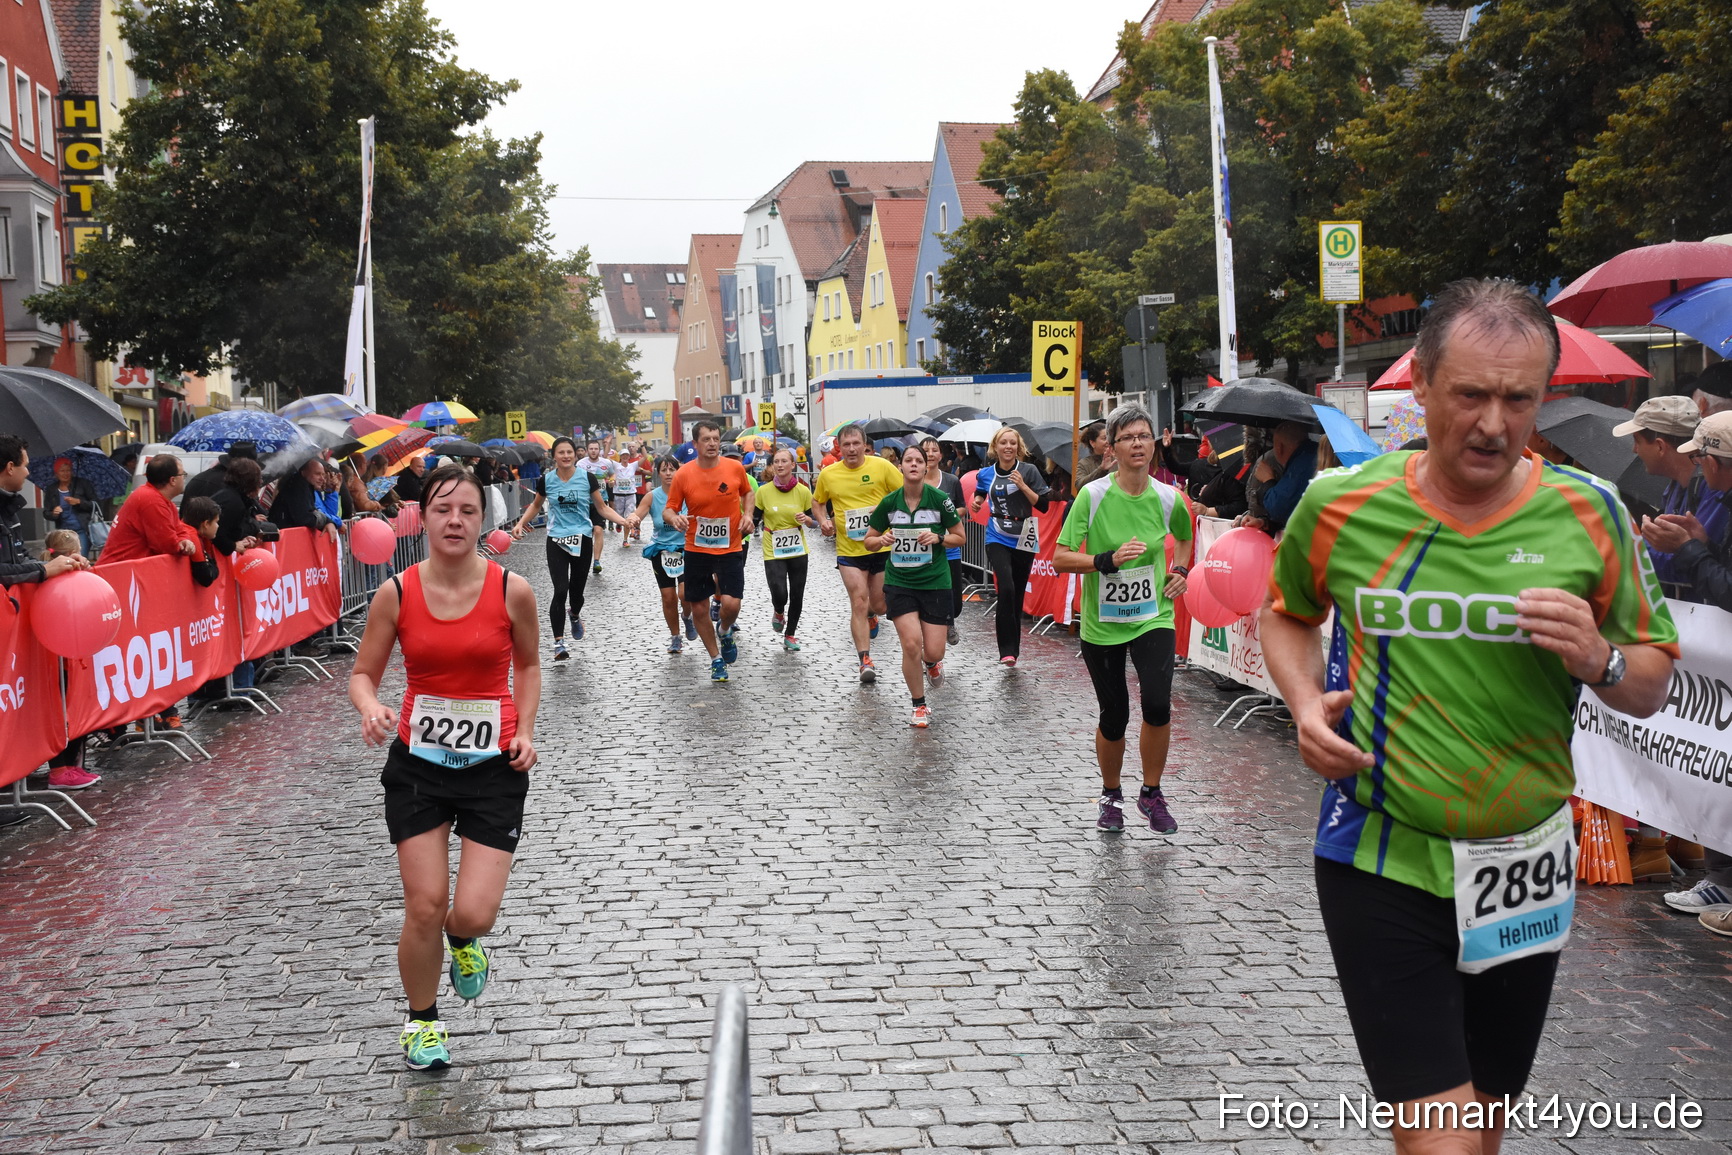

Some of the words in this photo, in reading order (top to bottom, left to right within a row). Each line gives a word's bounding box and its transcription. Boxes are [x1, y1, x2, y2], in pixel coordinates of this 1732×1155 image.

[63, 100, 104, 278] HOTE
[1038, 324, 1076, 338] Block
[1043, 343, 1069, 381] C
[762, 411, 772, 426] D
[511, 420, 522, 434] D
[699, 523, 727, 537] 2096
[848, 515, 870, 530] 279
[775, 534, 800, 548] 2272
[1105, 578, 1152, 603] 2328
[1118, 606, 1141, 617] Ingrid
[1355, 587, 1532, 643] BOC
[451, 701, 493, 713] BOCK
[1573, 700, 1602, 736] CH.
[418, 715, 493, 750] 2220
[441, 753, 470, 767] Julia
[1474, 838, 1574, 919] 2894
[1498, 912, 1560, 949] Helmut
